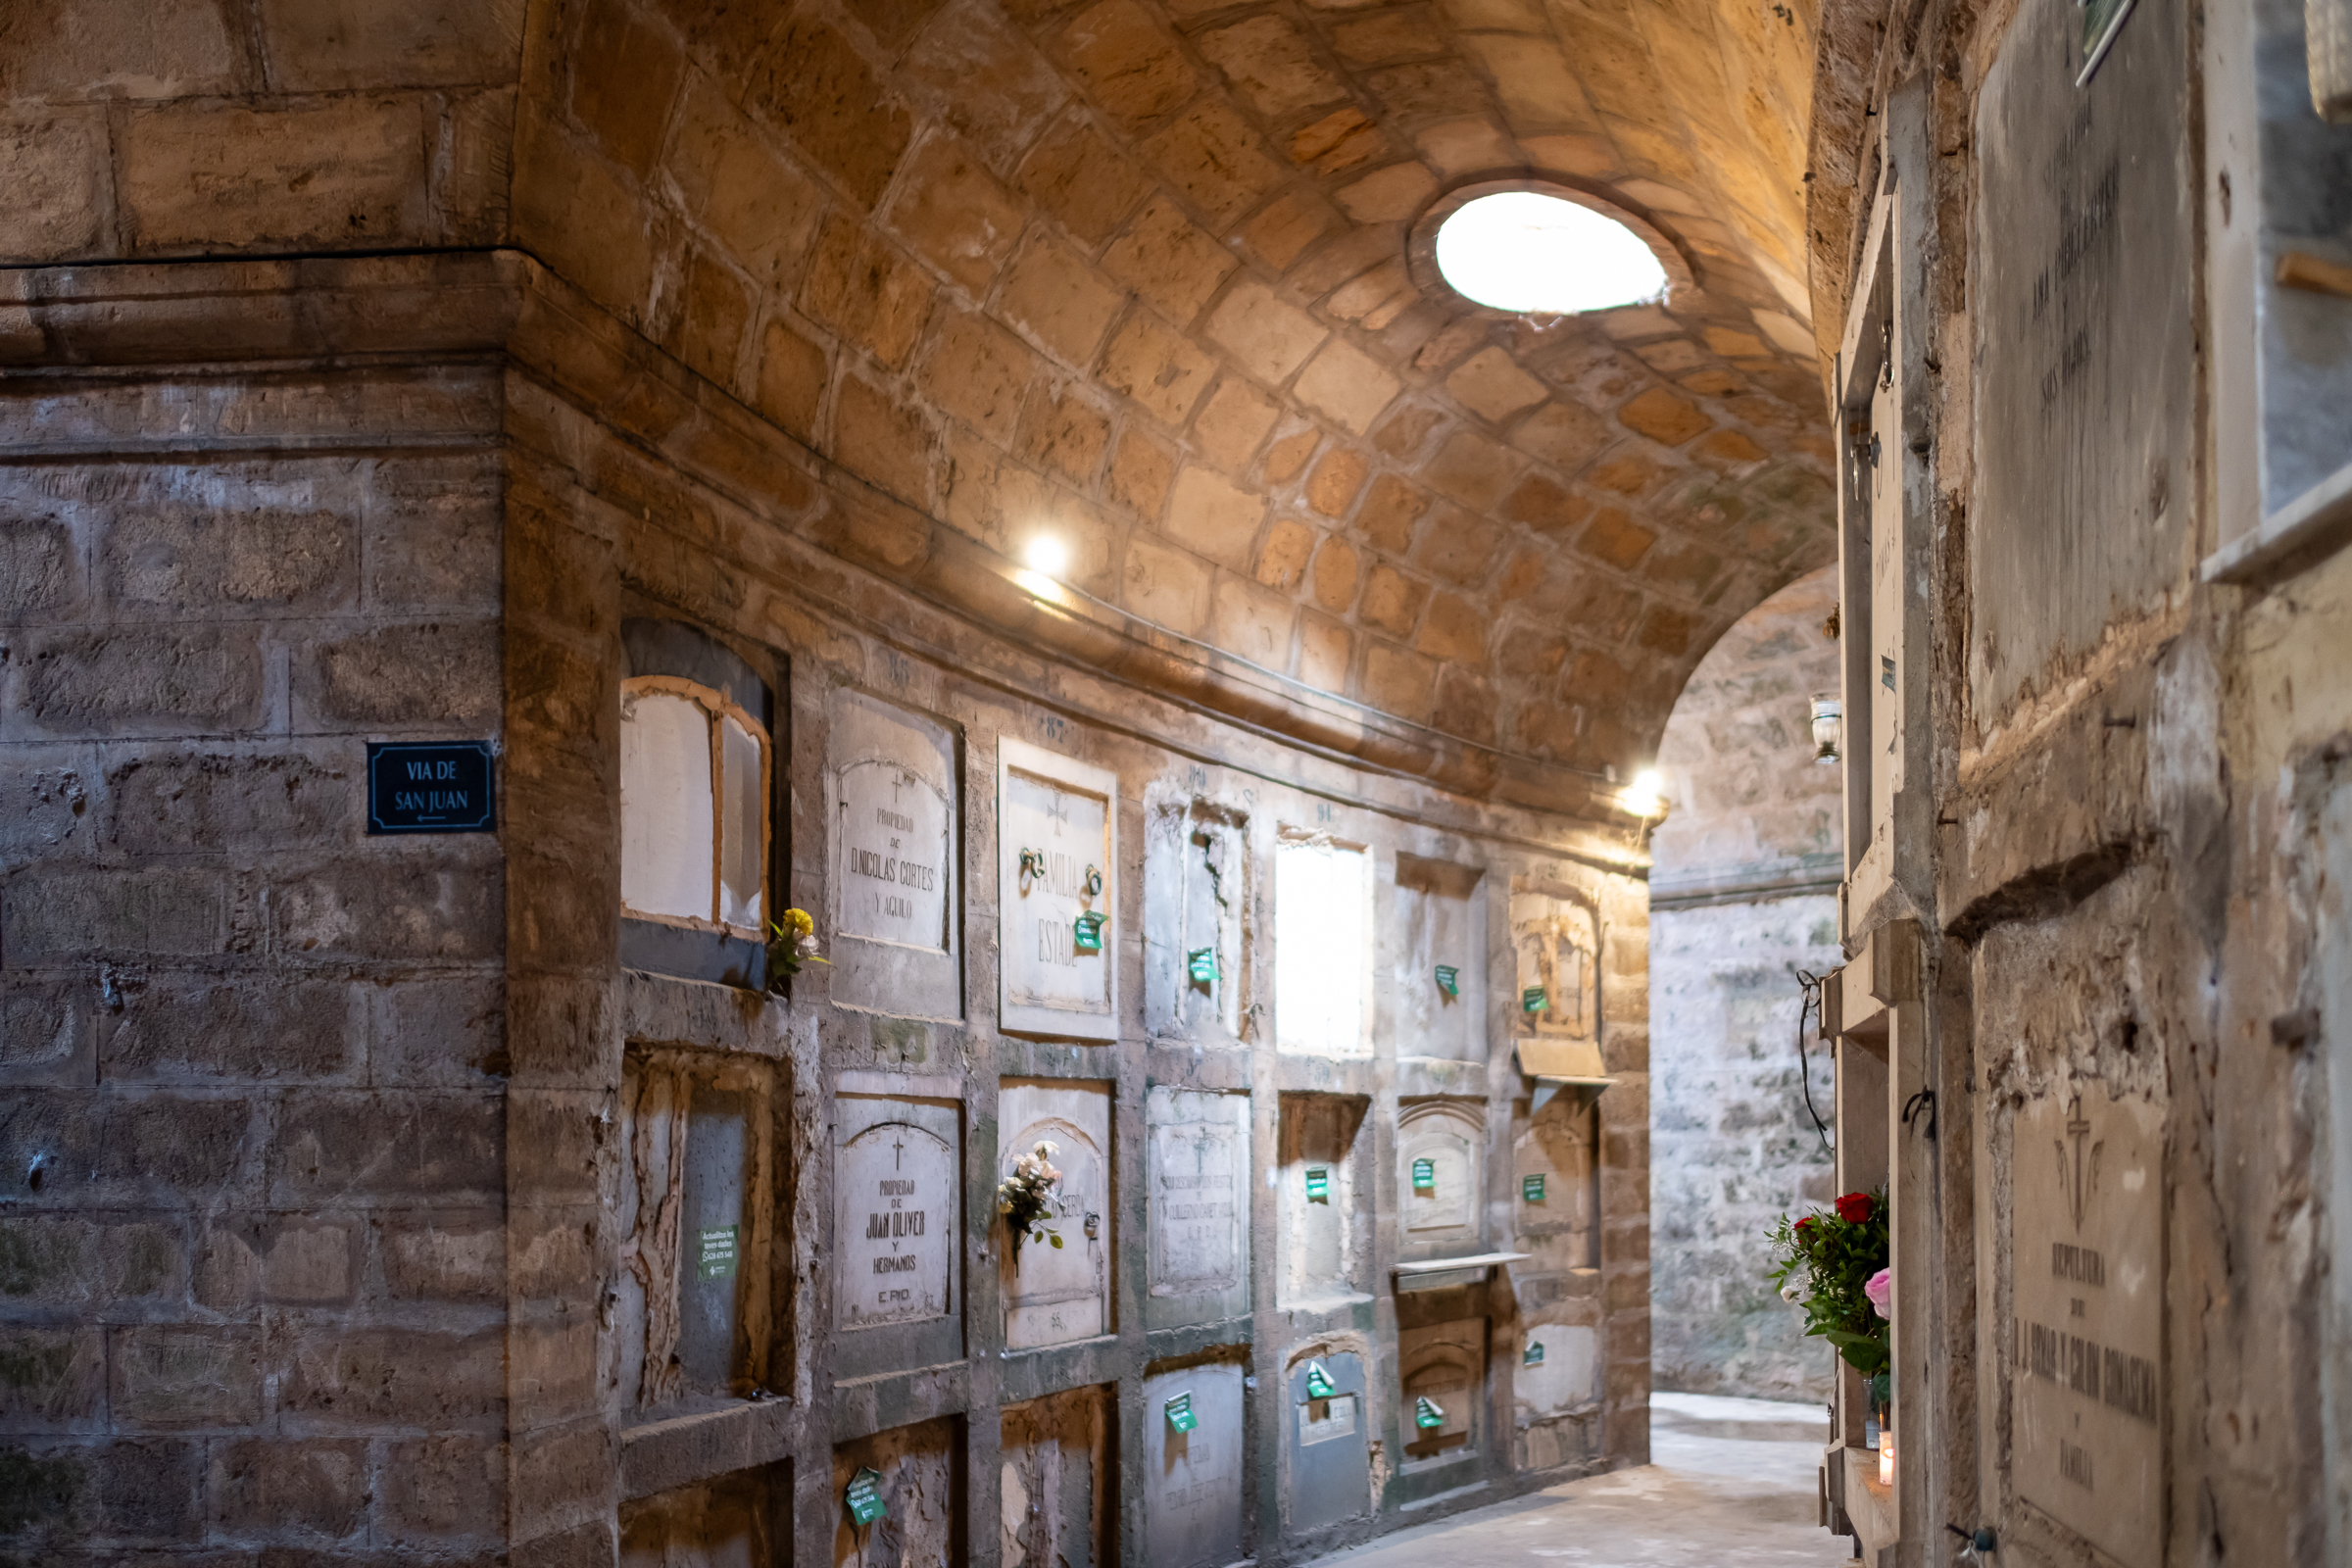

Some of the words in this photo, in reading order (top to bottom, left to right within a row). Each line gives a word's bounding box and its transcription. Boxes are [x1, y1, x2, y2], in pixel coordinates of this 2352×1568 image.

[2033, 263, 2049, 324] ANA
[2062, 295, 2069, 335] Y
[2041, 362, 2058, 414] SUS
[1046, 716, 1065, 744] 87
[407, 761, 433, 781] VIA
[437, 760, 457, 780] DE
[395, 791, 424, 810] SAN
[428, 790, 468, 813] JUAN
[877, 808, 914, 833] PROPIEDAD
[890, 838, 901, 849] DE
[900, 860, 934, 892] CORTES
[1037, 848, 1079, 900] FAMILIA
[874, 892, 881, 913] Y
[879, 1179, 915, 1197] PROPIEDAD
[891, 1199, 902, 1208] DE
[866, 1211, 890, 1240] JUAN
[893, 1209, 925, 1238] OLIVER
[892, 1241, 899, 1252] Y
[873, 1254, 915, 1274] HERMANOS
[2052, 1243, 2106, 1288] SEPULTURA
[2071, 1298, 2085, 1317] DE
[2074, 1412, 2081, 1429] Y
[2060, 1438, 2093, 1493] FAMILIA
